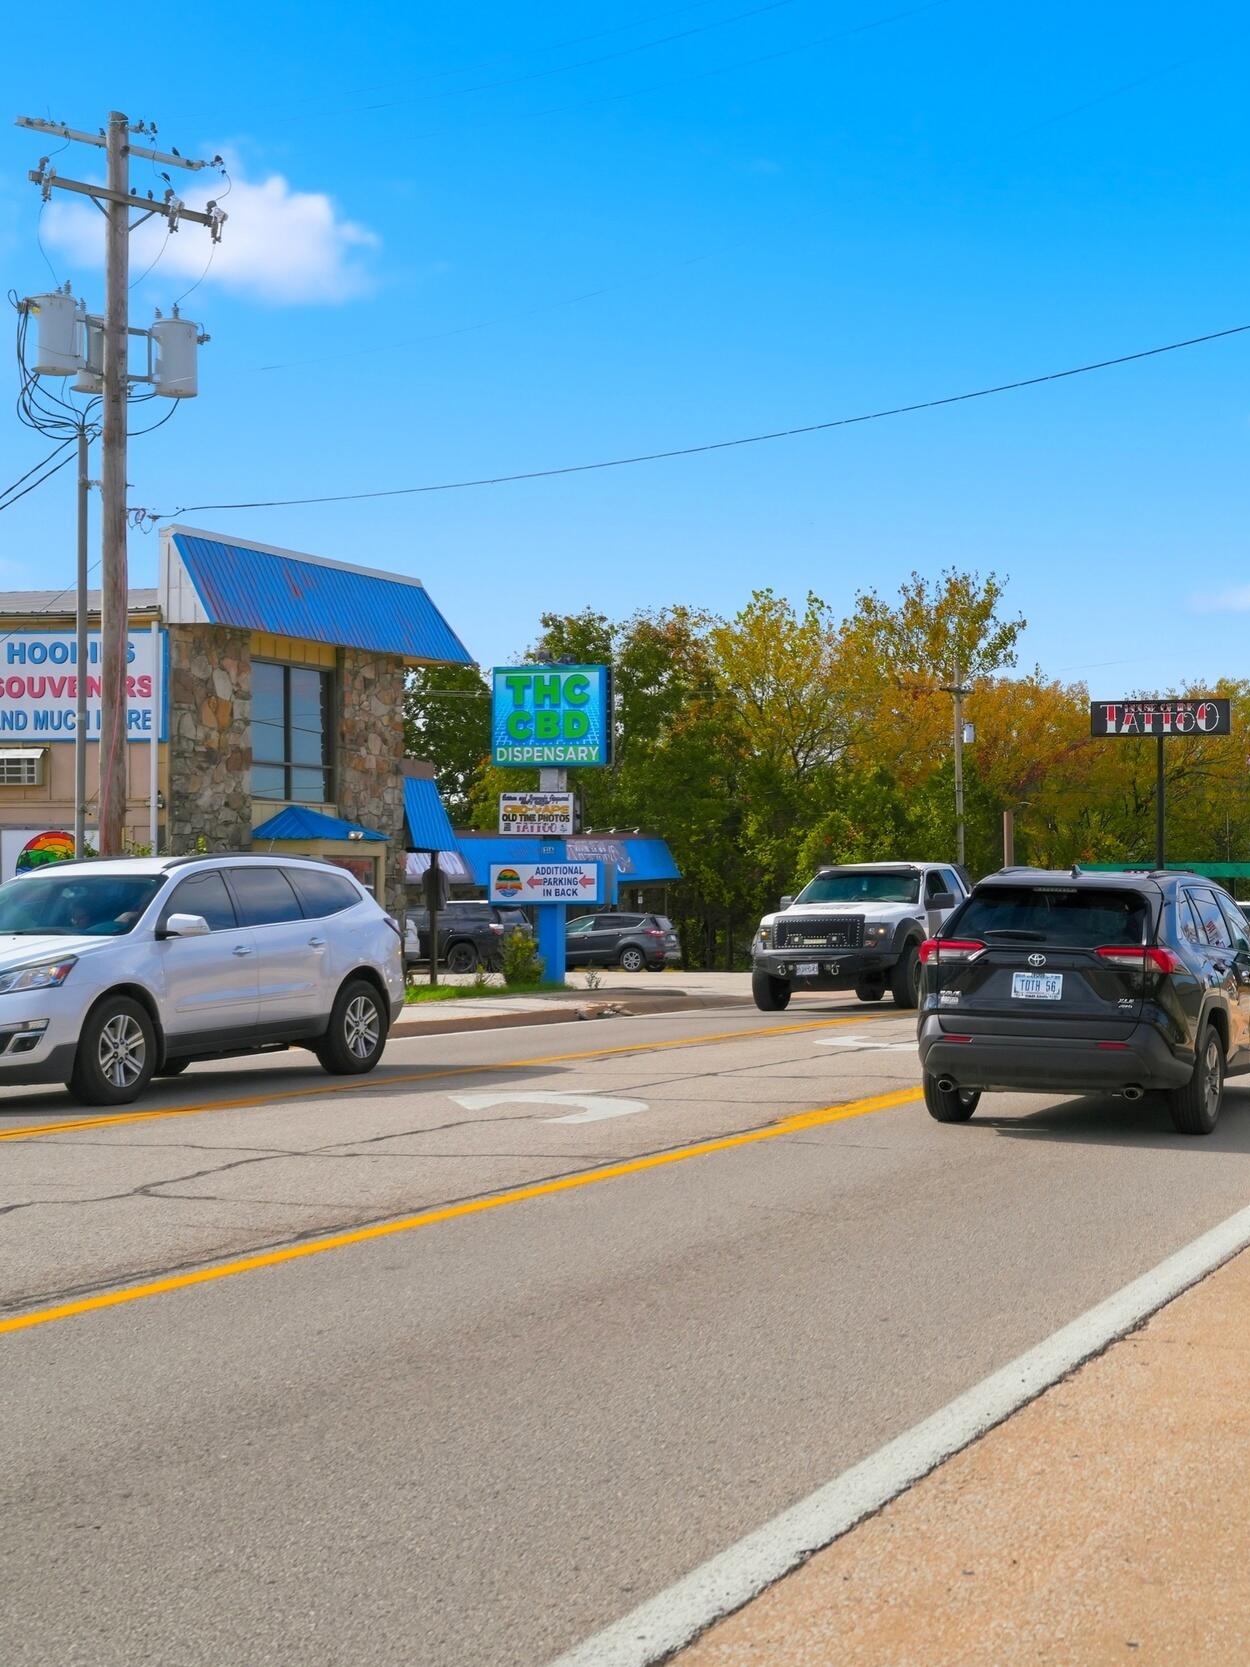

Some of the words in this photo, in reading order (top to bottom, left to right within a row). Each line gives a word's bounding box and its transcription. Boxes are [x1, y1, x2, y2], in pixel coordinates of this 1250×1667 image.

[506, 674, 590, 706] THC
[0, 709, 27, 730] ND
[506, 710, 590, 740] CBD
[1100, 702, 1219, 733] TATTOO
[496, 746, 599, 761] DISPENSARY
[502, 813, 517, 821] OLD
[519, 813, 536, 822] TIME
[538, 814, 570, 822] PHOTOS
[535, 866, 583, 875] ADDITIONAL
[543, 877, 578, 886] PARKING
[543, 888, 551, 896] IN
[555, 888, 578, 896] BACK
